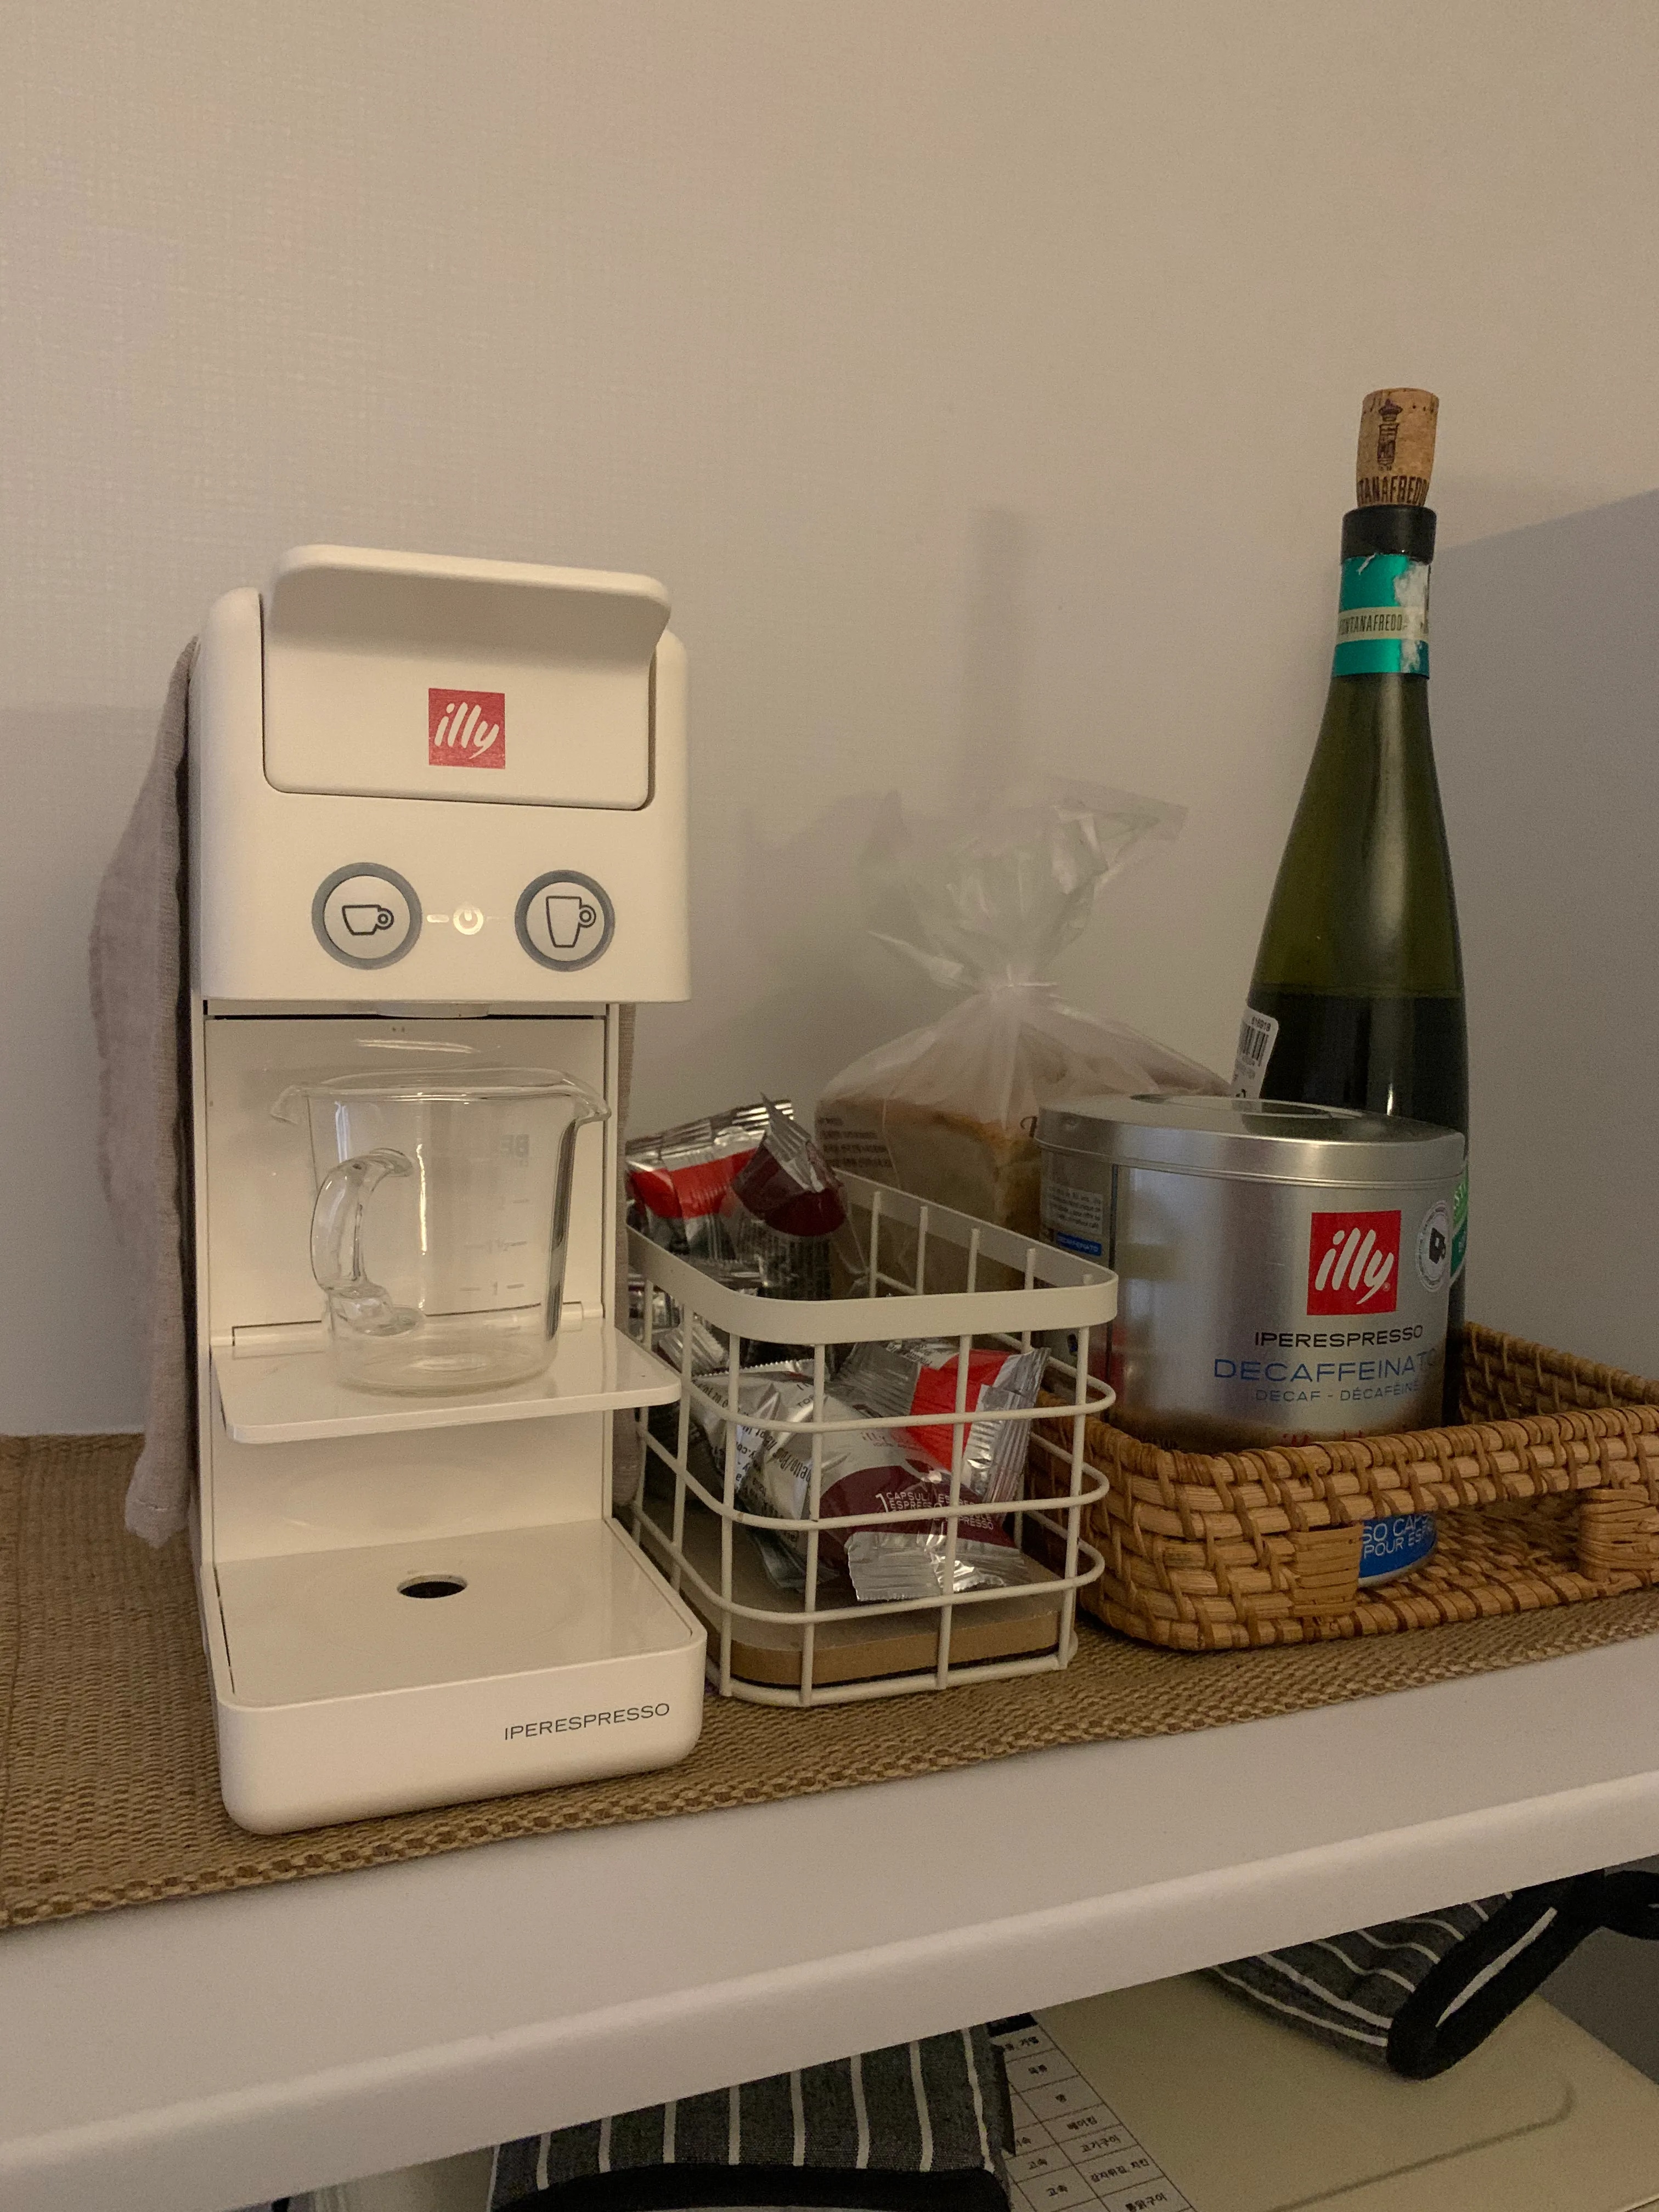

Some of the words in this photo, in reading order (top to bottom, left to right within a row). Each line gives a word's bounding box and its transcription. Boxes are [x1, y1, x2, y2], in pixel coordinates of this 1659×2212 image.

[434, 702, 499, 759] illy
[1315, 1227, 1394, 1305] illy
[1255, 1325, 1423, 1348] IPERESPRESSO
[1255, 1390, 1321, 1402] DECAF
[1364, 1537, 1404, 1559] POUR
[504, 1703, 669, 1740] IPERESPRESSO
[1067, 2115, 1097, 2130] 베이킹
[1028, 2158, 1047, 2170] 고속
[1080, 2134, 1121, 2153] 고기구이
[1046, 2185, 1068, 2197] 고속
